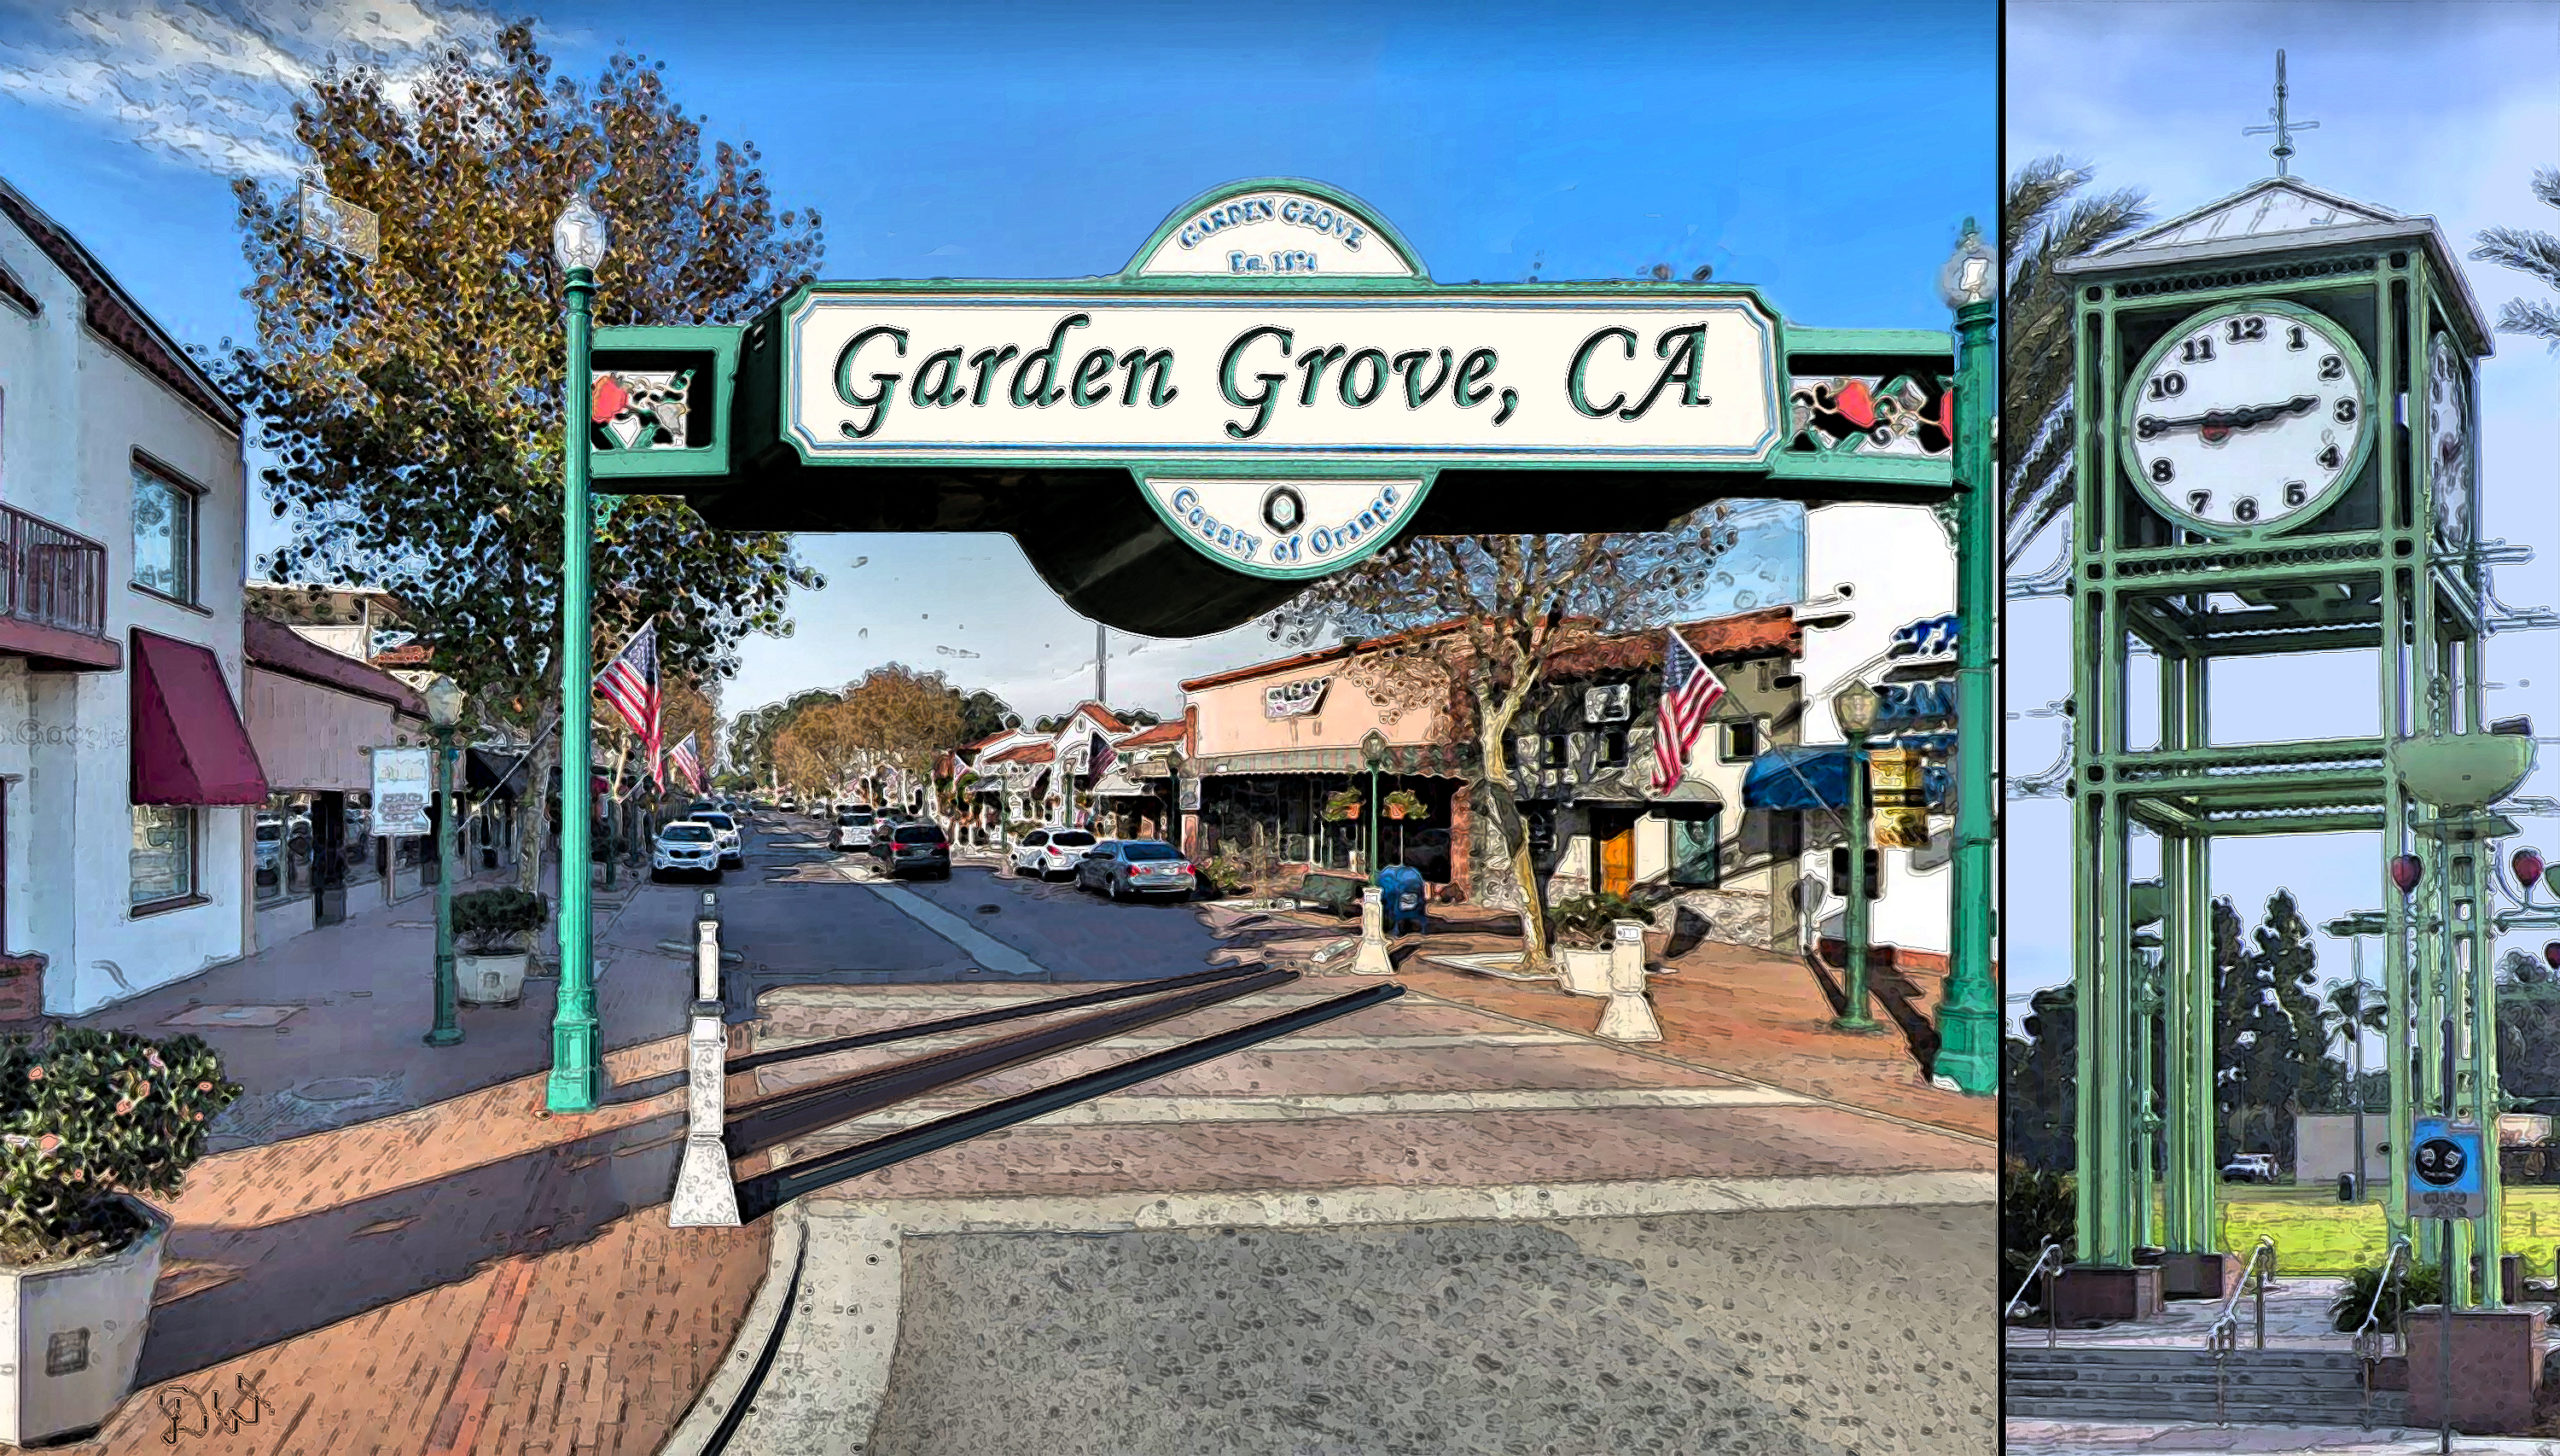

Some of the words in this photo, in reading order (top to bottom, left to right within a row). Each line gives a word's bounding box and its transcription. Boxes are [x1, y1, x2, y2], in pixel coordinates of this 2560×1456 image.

[1179, 199, 1275, 249] GARDEN
[1279, 199, 1366, 251] GROVE
[2227, 316, 2265, 343] 12
[2288, 325, 2307, 350] 1
[2181, 336, 2215, 363] 11
[834, 312, 1177, 438] Garden
[1219, 325, 1519, 439] Grove,
[1566, 323, 1711, 420] CA
[2319, 355, 2344, 380] 2
[2149, 371, 2186, 401] 10
[2334, 397, 2357, 423] 3
[2136, 415, 2160, 441] 9
[2317, 444, 2342, 469] 4
[2151, 458, 2174, 484] 8
[2188, 490, 2211, 515] 7
[2284, 481, 2307, 507] 5
[2233, 497, 2258, 523] 6
[1273, 535, 1303, 562] of
